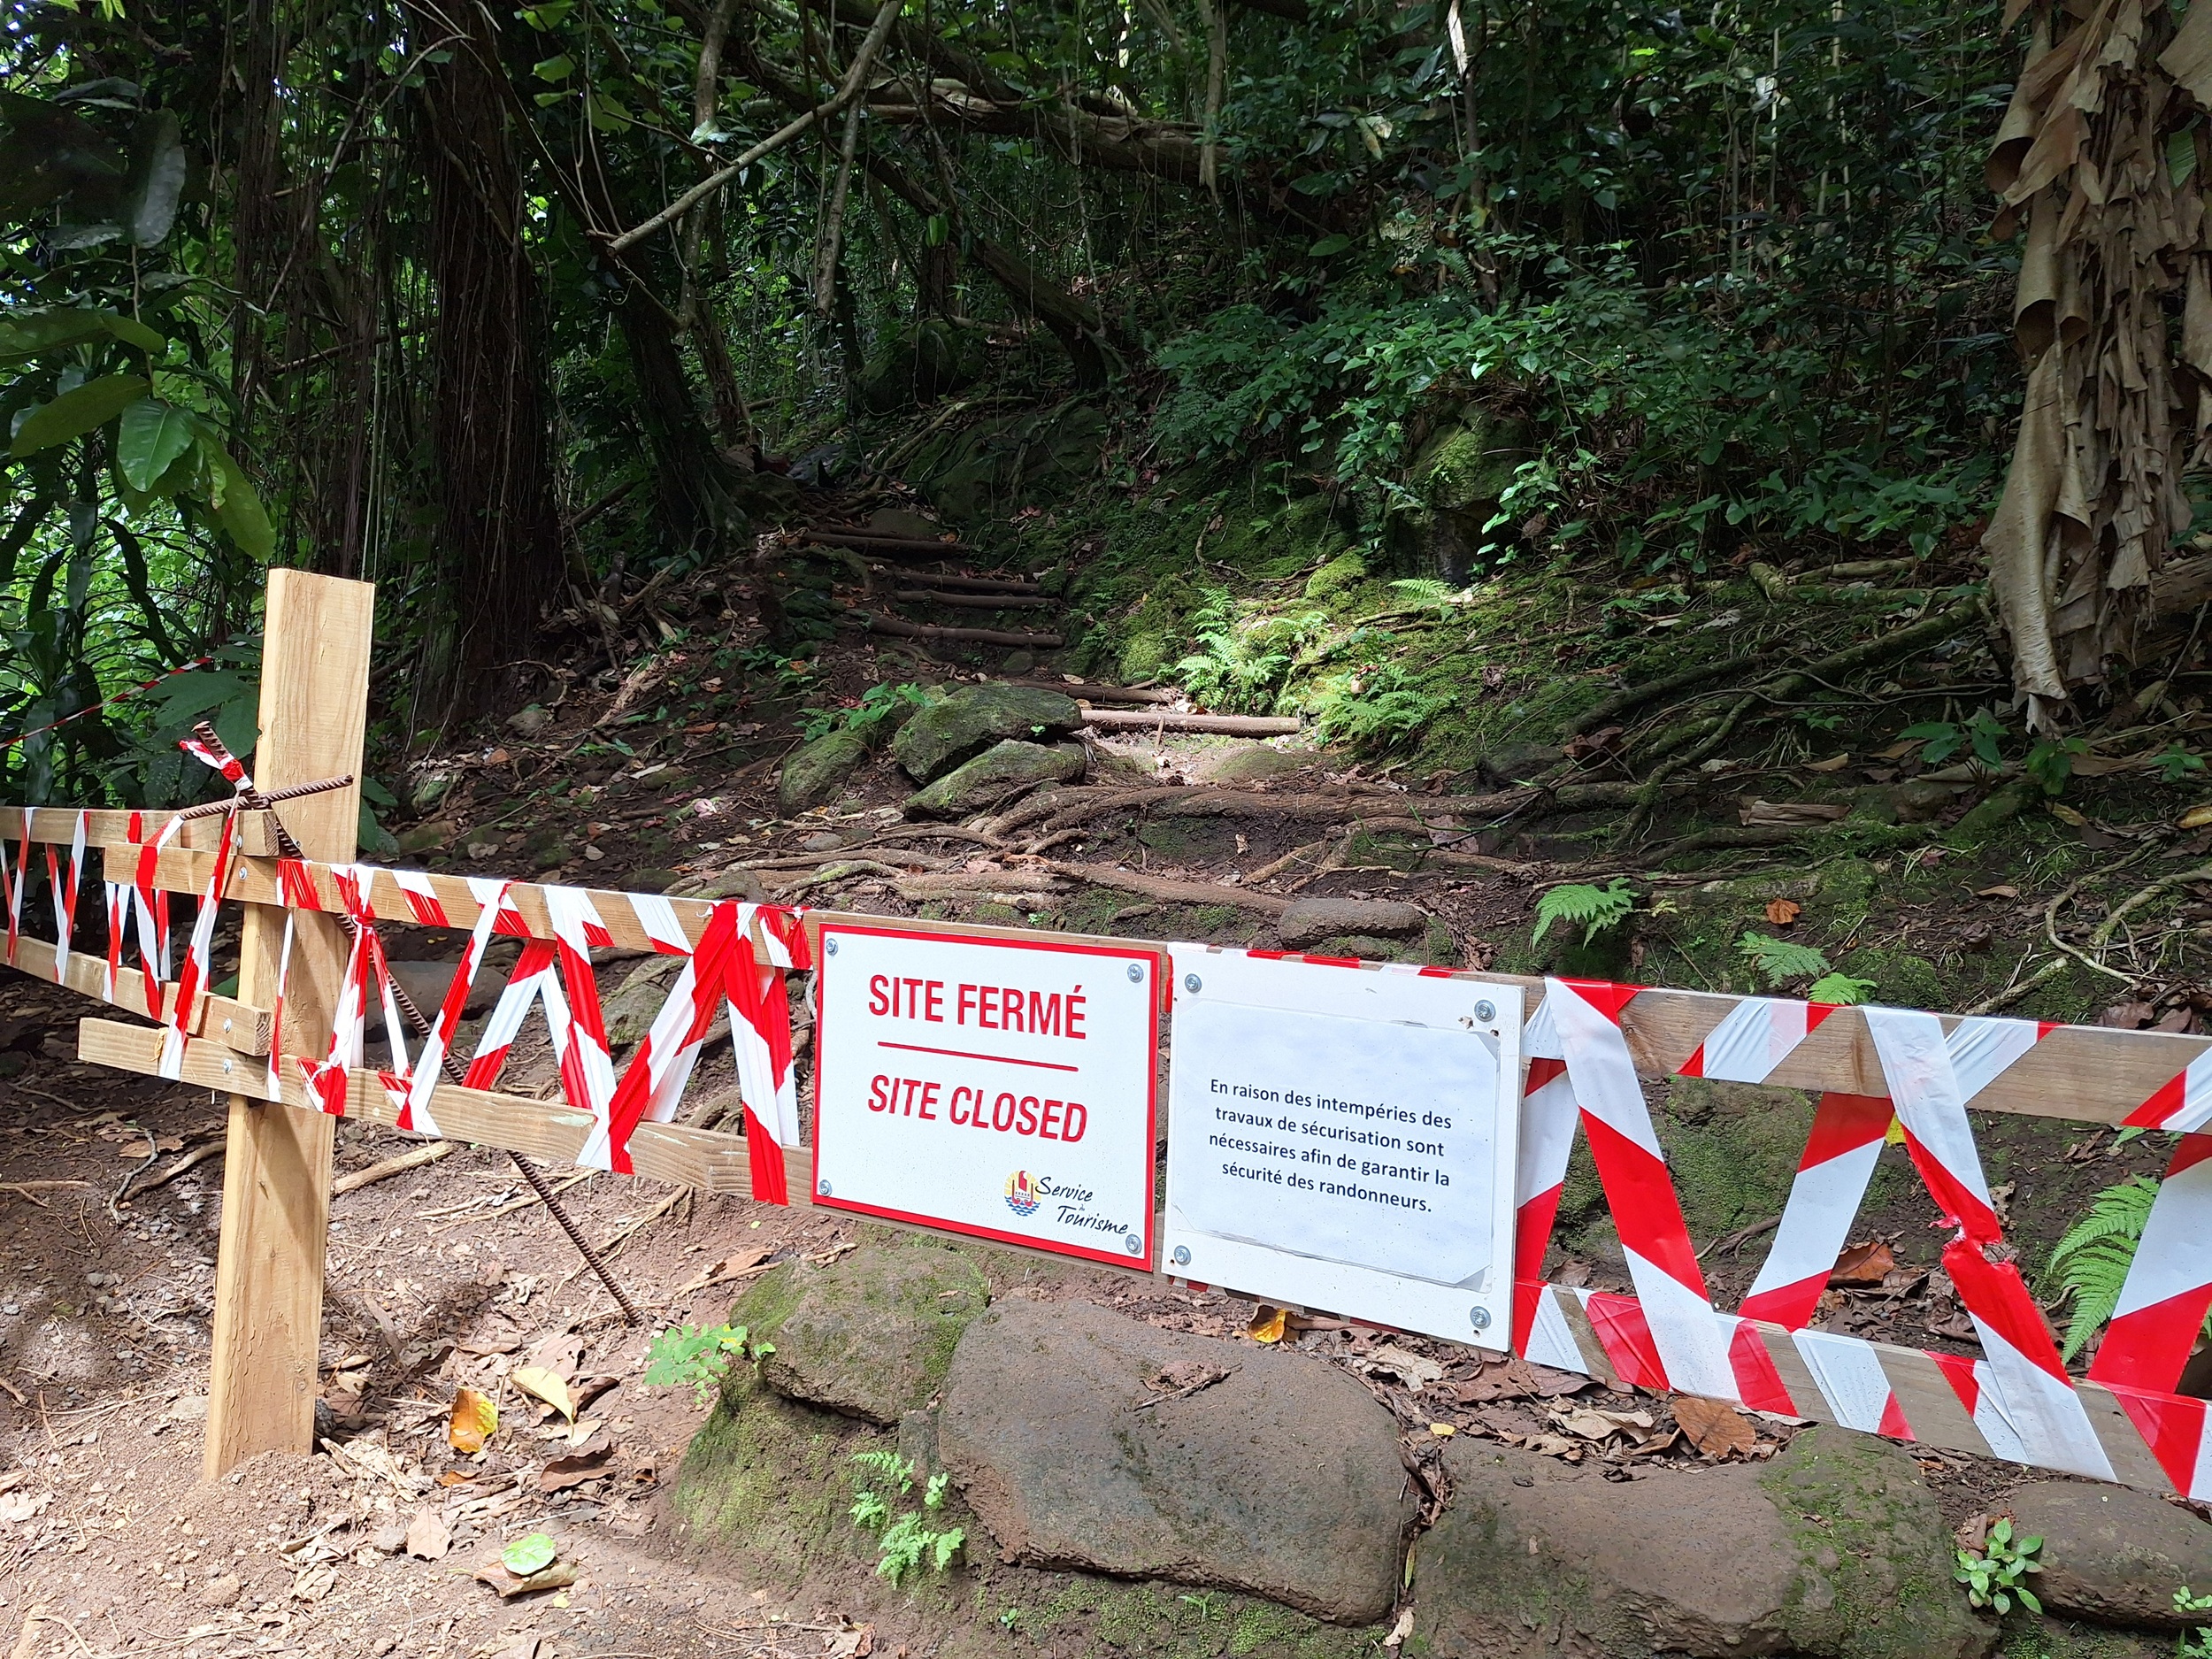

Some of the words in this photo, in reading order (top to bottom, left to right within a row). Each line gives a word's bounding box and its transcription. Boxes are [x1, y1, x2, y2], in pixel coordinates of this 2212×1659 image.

[868, 974, 944, 1023] SITE
[957, 984, 1087, 1040] FERMÉ
[867, 1074, 941, 1121] SITE
[949, 1086, 1087, 1143] CLOSED
[1210, 1079, 1228, 1094] En
[1233, 1084, 1279, 1102] raison
[1284, 1089, 1312, 1108] des
[1317, 1094, 1417, 1124] intempéries
[1422, 1110, 1452, 1129] des
[1215, 1107, 1273, 1129] travaux
[1277, 1116, 1297, 1133] de
[1301, 1120, 1401, 1150] sécurisation
[1406, 1140, 1445, 1157] sont
[1210, 1133, 1296, 1160] nécessaires
[1301, 1148, 1332, 1166] afin
[1336, 1153, 1356, 1171] de
[1361, 1161, 1430, 1183] garantir
[1435, 1169, 1449, 1187] la
[1034, 1176, 1094, 1202] Service
[1222, 1161, 1282, 1185] sécurité
[1286, 1171, 1315, 1191] des
[1319, 1181, 1432, 1213] randonneurs.
[1056, 1205, 1129, 1234] Tourisme
